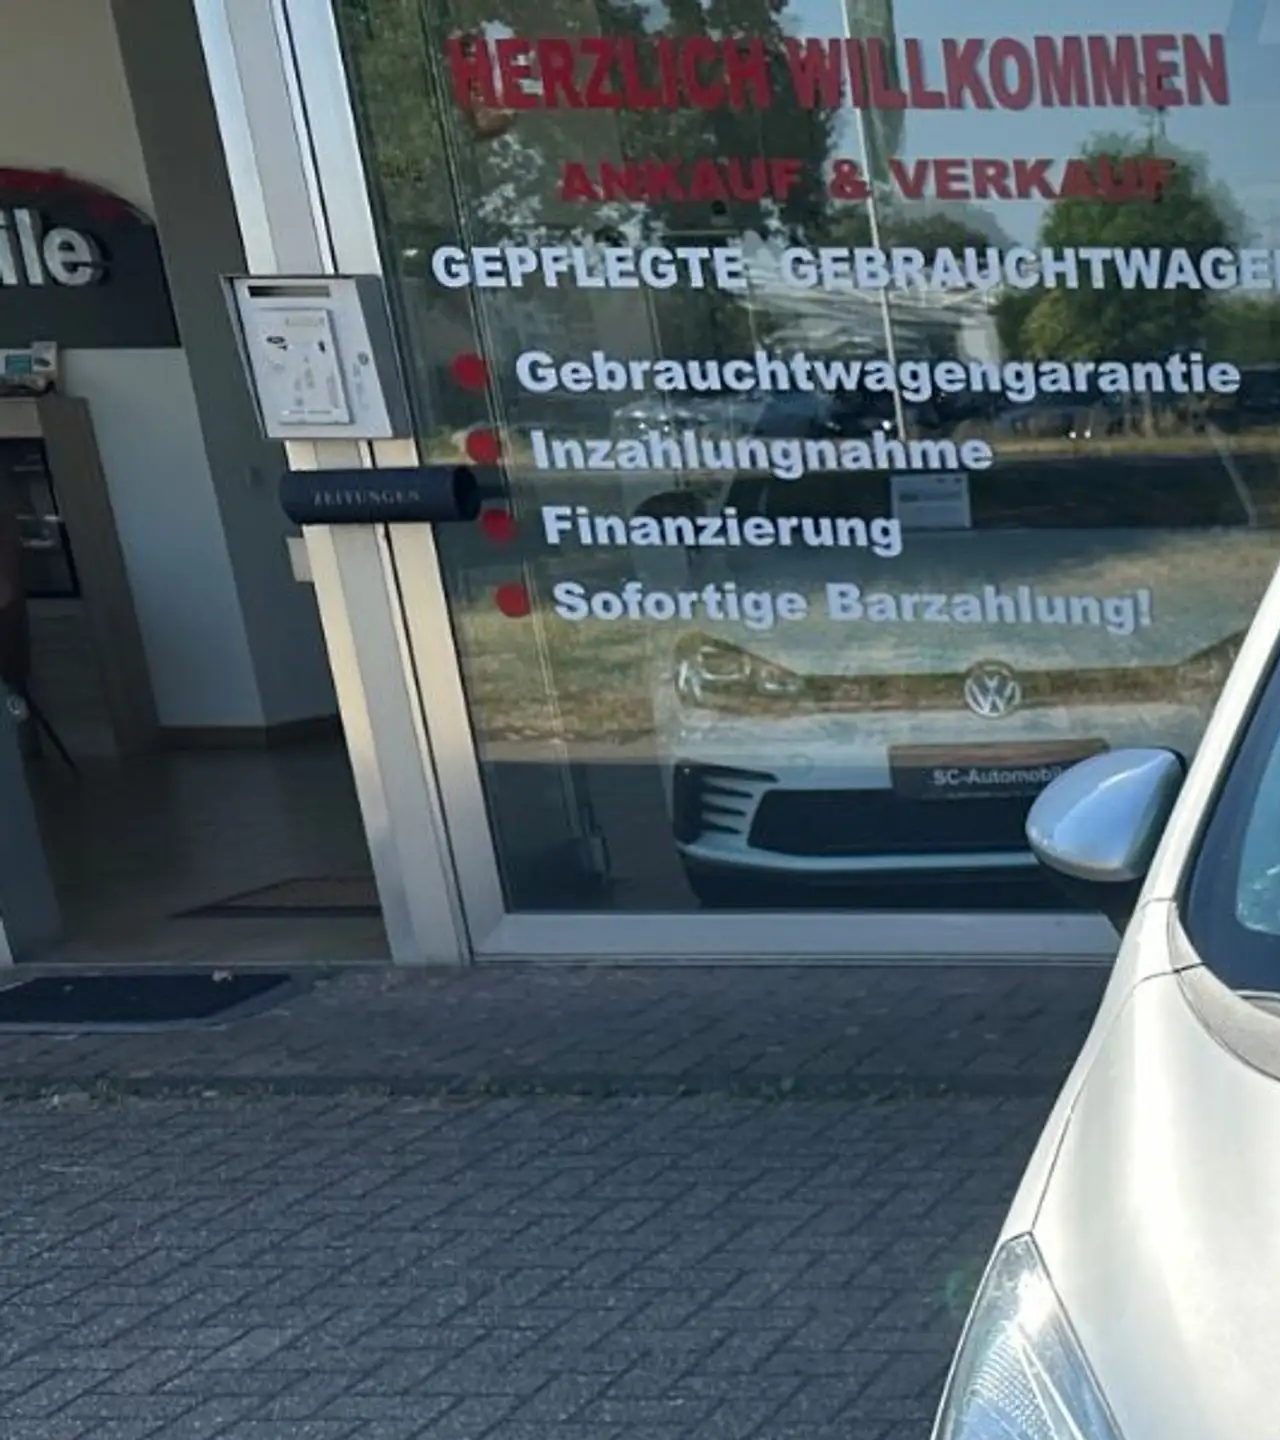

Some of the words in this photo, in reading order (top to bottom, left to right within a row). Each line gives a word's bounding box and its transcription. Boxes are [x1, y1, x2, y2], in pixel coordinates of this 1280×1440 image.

[446, 36, 773, 110] HERZLICH
[783, 33, 1230, 111] WILLKOMMEN
[560, 157, 805, 202] ANKAUF
[829, 158, 869, 201] &
[888, 156, 1176, 202] VERKAUF
[431, 246, 748, 289] GEPFLEGTE
[515, 349, 1241, 402] Gebrauchtwagengarantie
[530, 428, 994, 480] Inzahlungnahme
[540, 504, 902, 558] Finanzierung
[552, 581, 808, 631] Sofortige
[825, 581, 1153, 636] Barzahlung!
